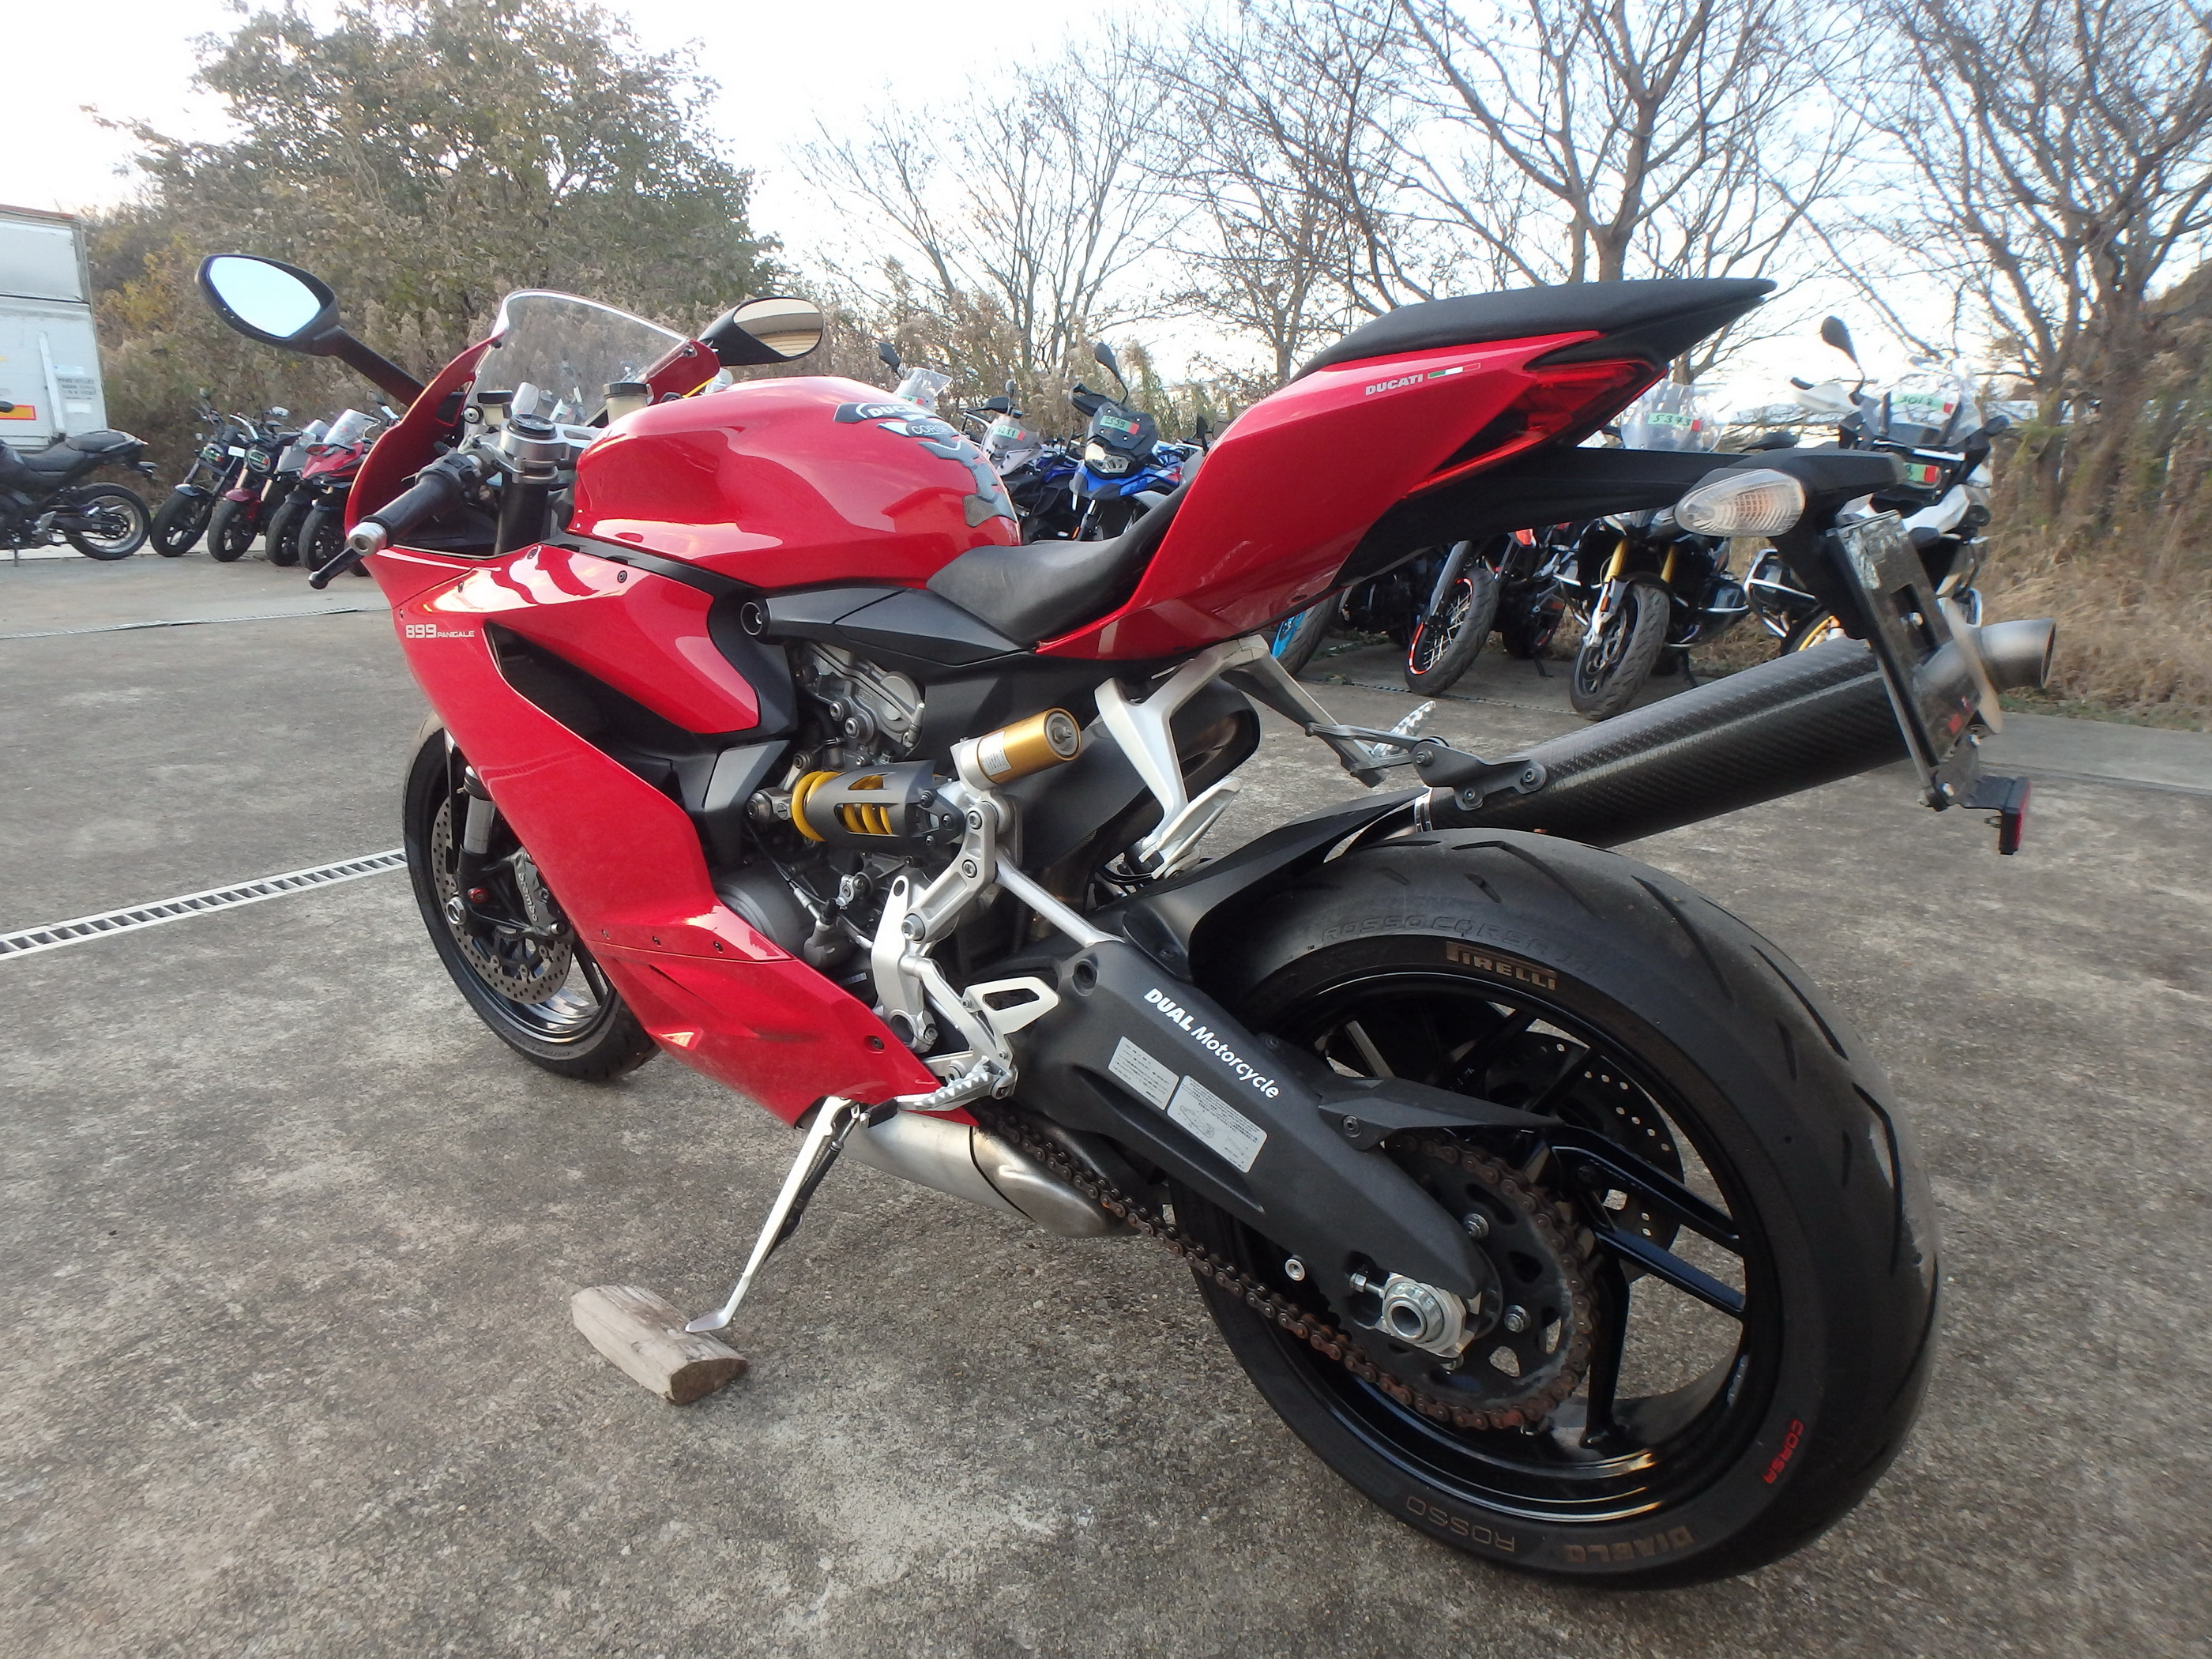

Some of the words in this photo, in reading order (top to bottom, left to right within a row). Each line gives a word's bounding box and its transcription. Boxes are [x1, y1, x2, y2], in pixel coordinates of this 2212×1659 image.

[1365, 374, 1424, 395] DUCATI
[867, 405, 920, 418] DUCA
[911, 424, 951, 434] CORSE
[405, 623, 437, 638] 899
[517, 872, 539, 922] brembo
[1322, 914, 1424, 942] ROSSO
[1446, 941, 1558, 991] PIRELLI
[1144, 988, 1194, 1031] DUAL
[1191, 1025, 1280, 1099] Motorcycle
[1762, 1419, 1804, 1484] CORSA
[1405, 1495, 1515, 1553] ROSSO
[1563, 1525, 1695, 1563] DIABLO
